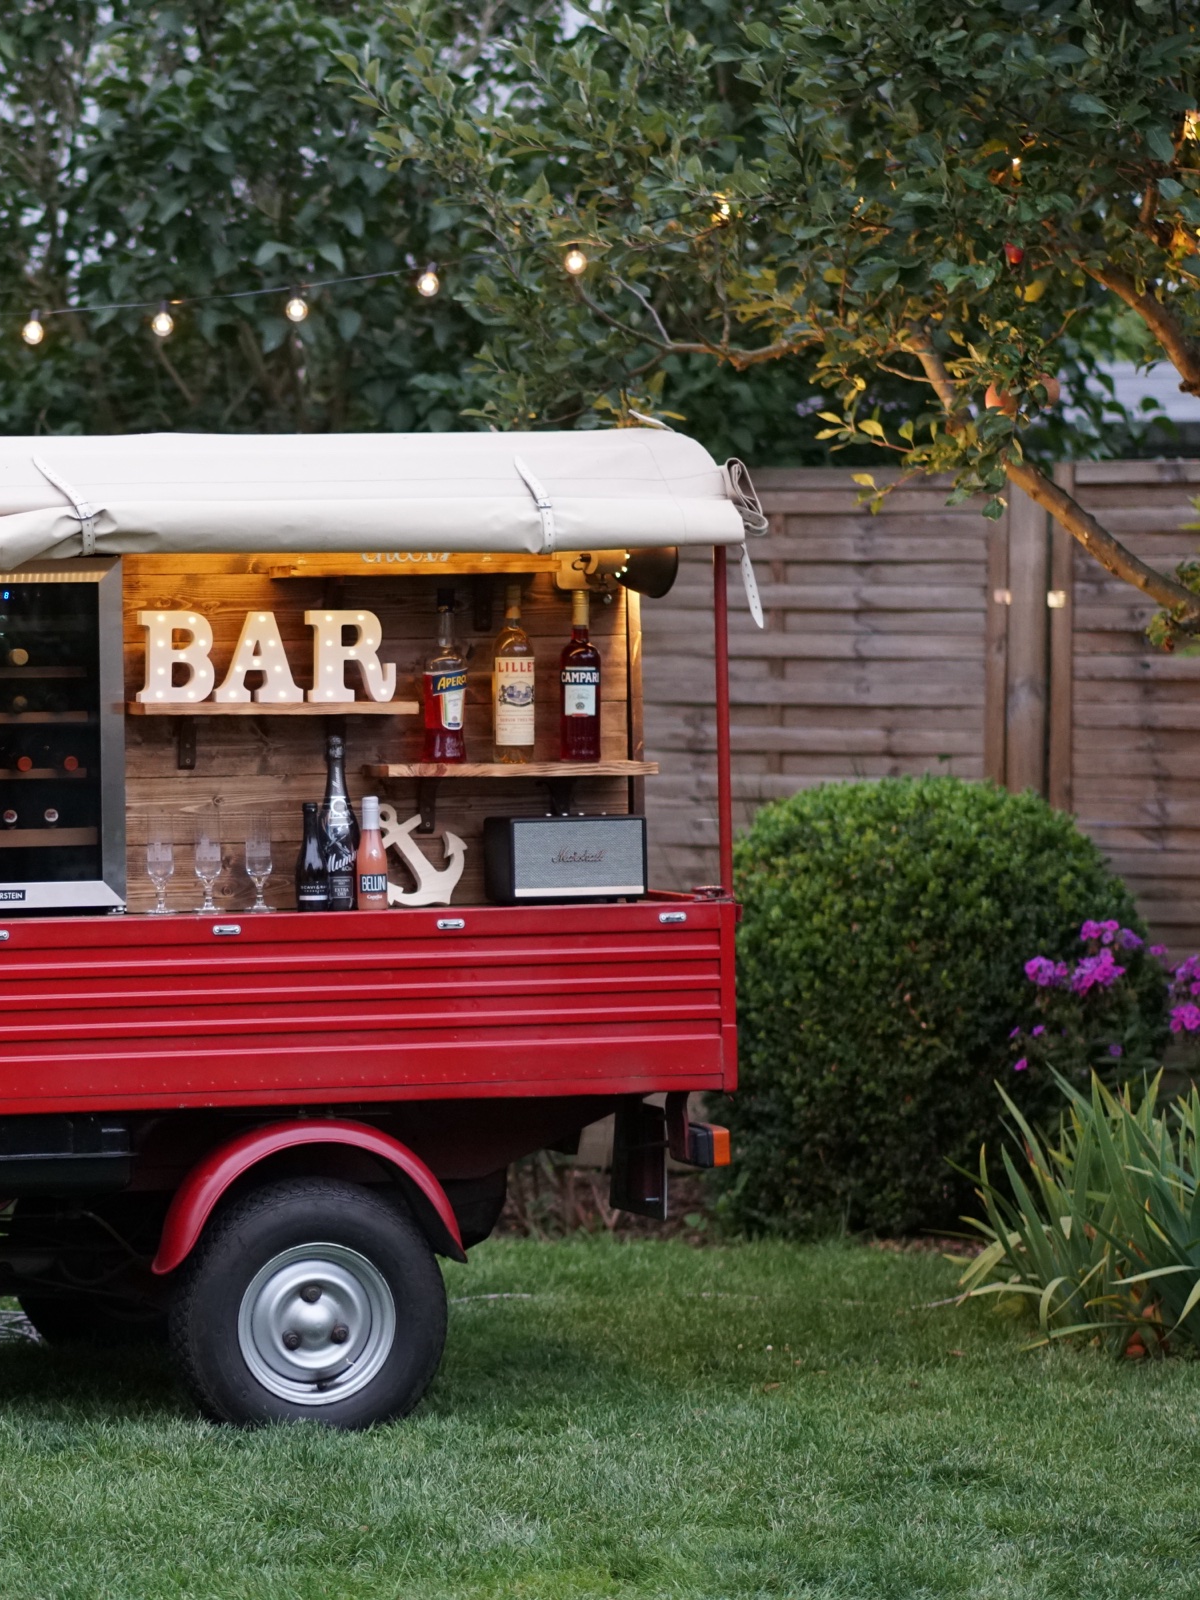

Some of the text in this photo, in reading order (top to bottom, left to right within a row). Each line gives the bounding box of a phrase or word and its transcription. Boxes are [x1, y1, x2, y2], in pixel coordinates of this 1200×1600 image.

[136, 610, 397, 703] BAR
[498, 661, 535, 673] LILLE
[437, 675, 467, 690] APERO
